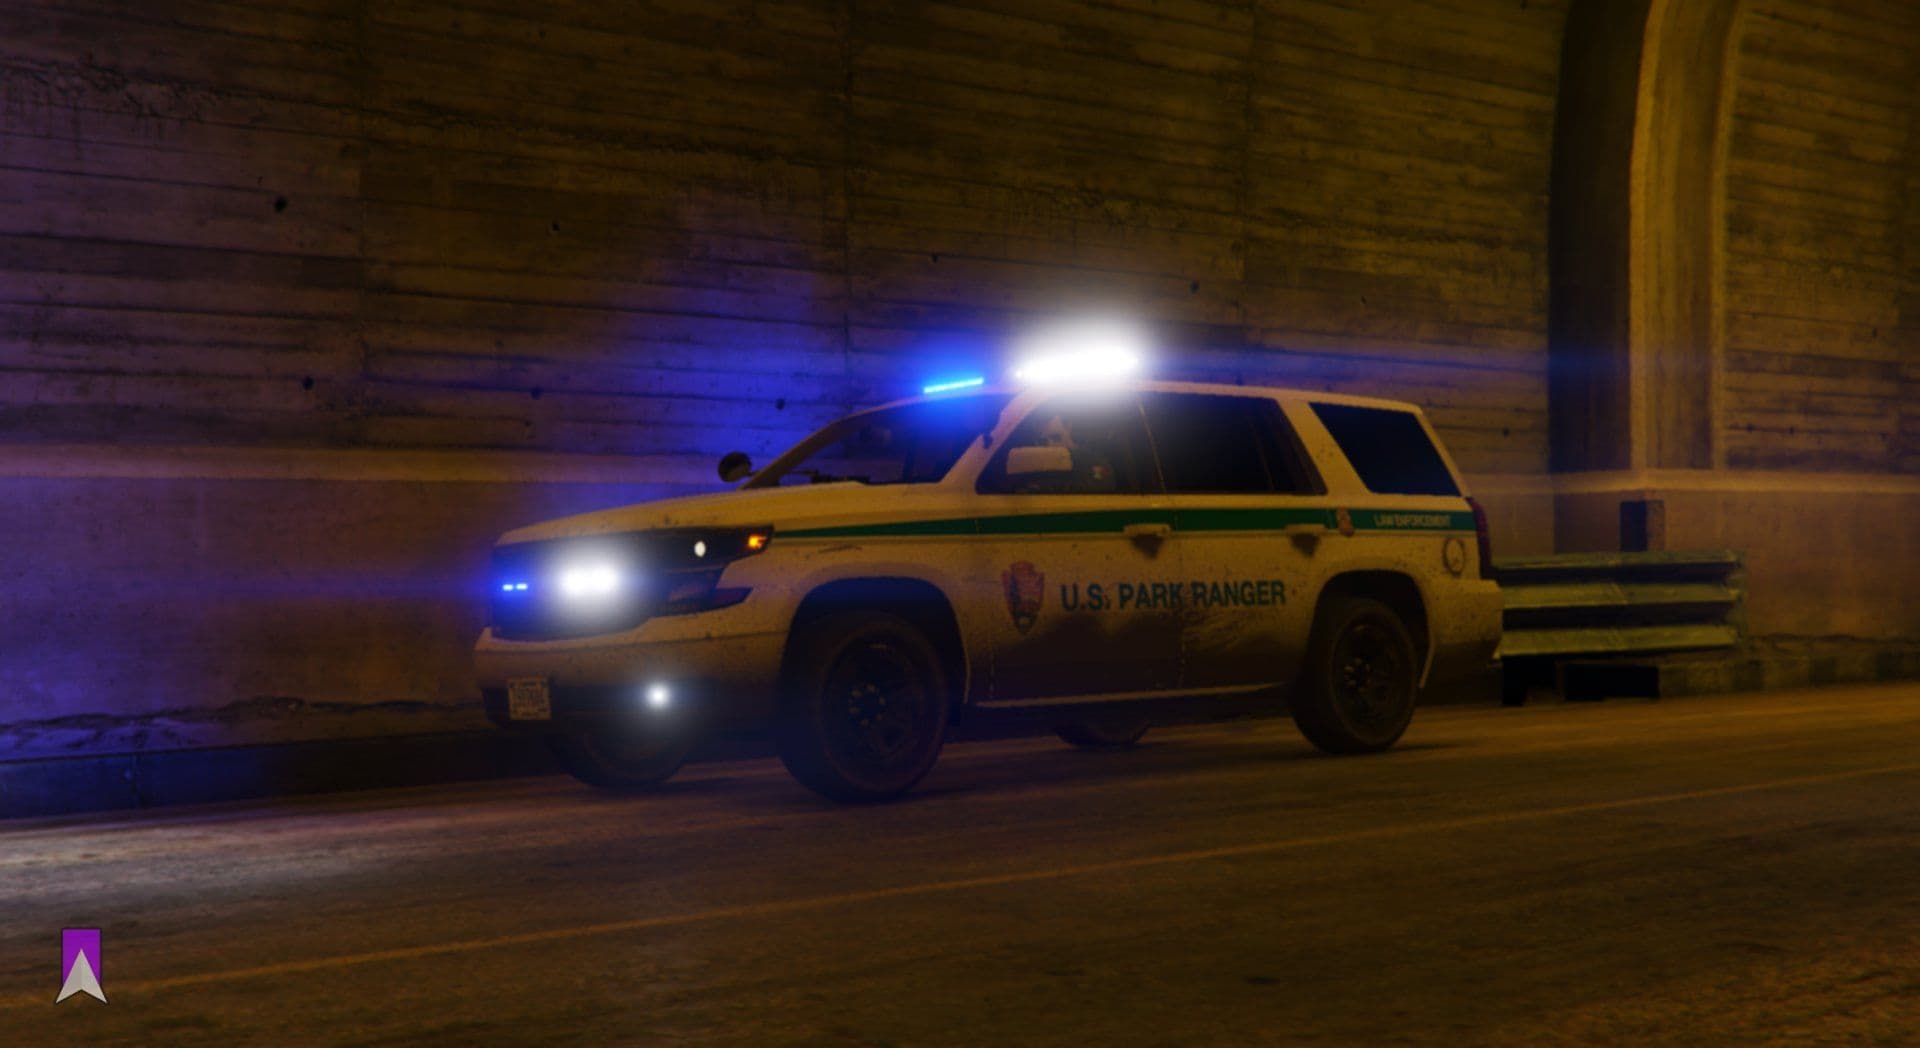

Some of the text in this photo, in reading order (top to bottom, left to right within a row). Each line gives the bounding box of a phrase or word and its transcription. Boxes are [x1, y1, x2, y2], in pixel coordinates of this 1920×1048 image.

[1060, 580, 1287, 611] U.S. PARK RANGER
